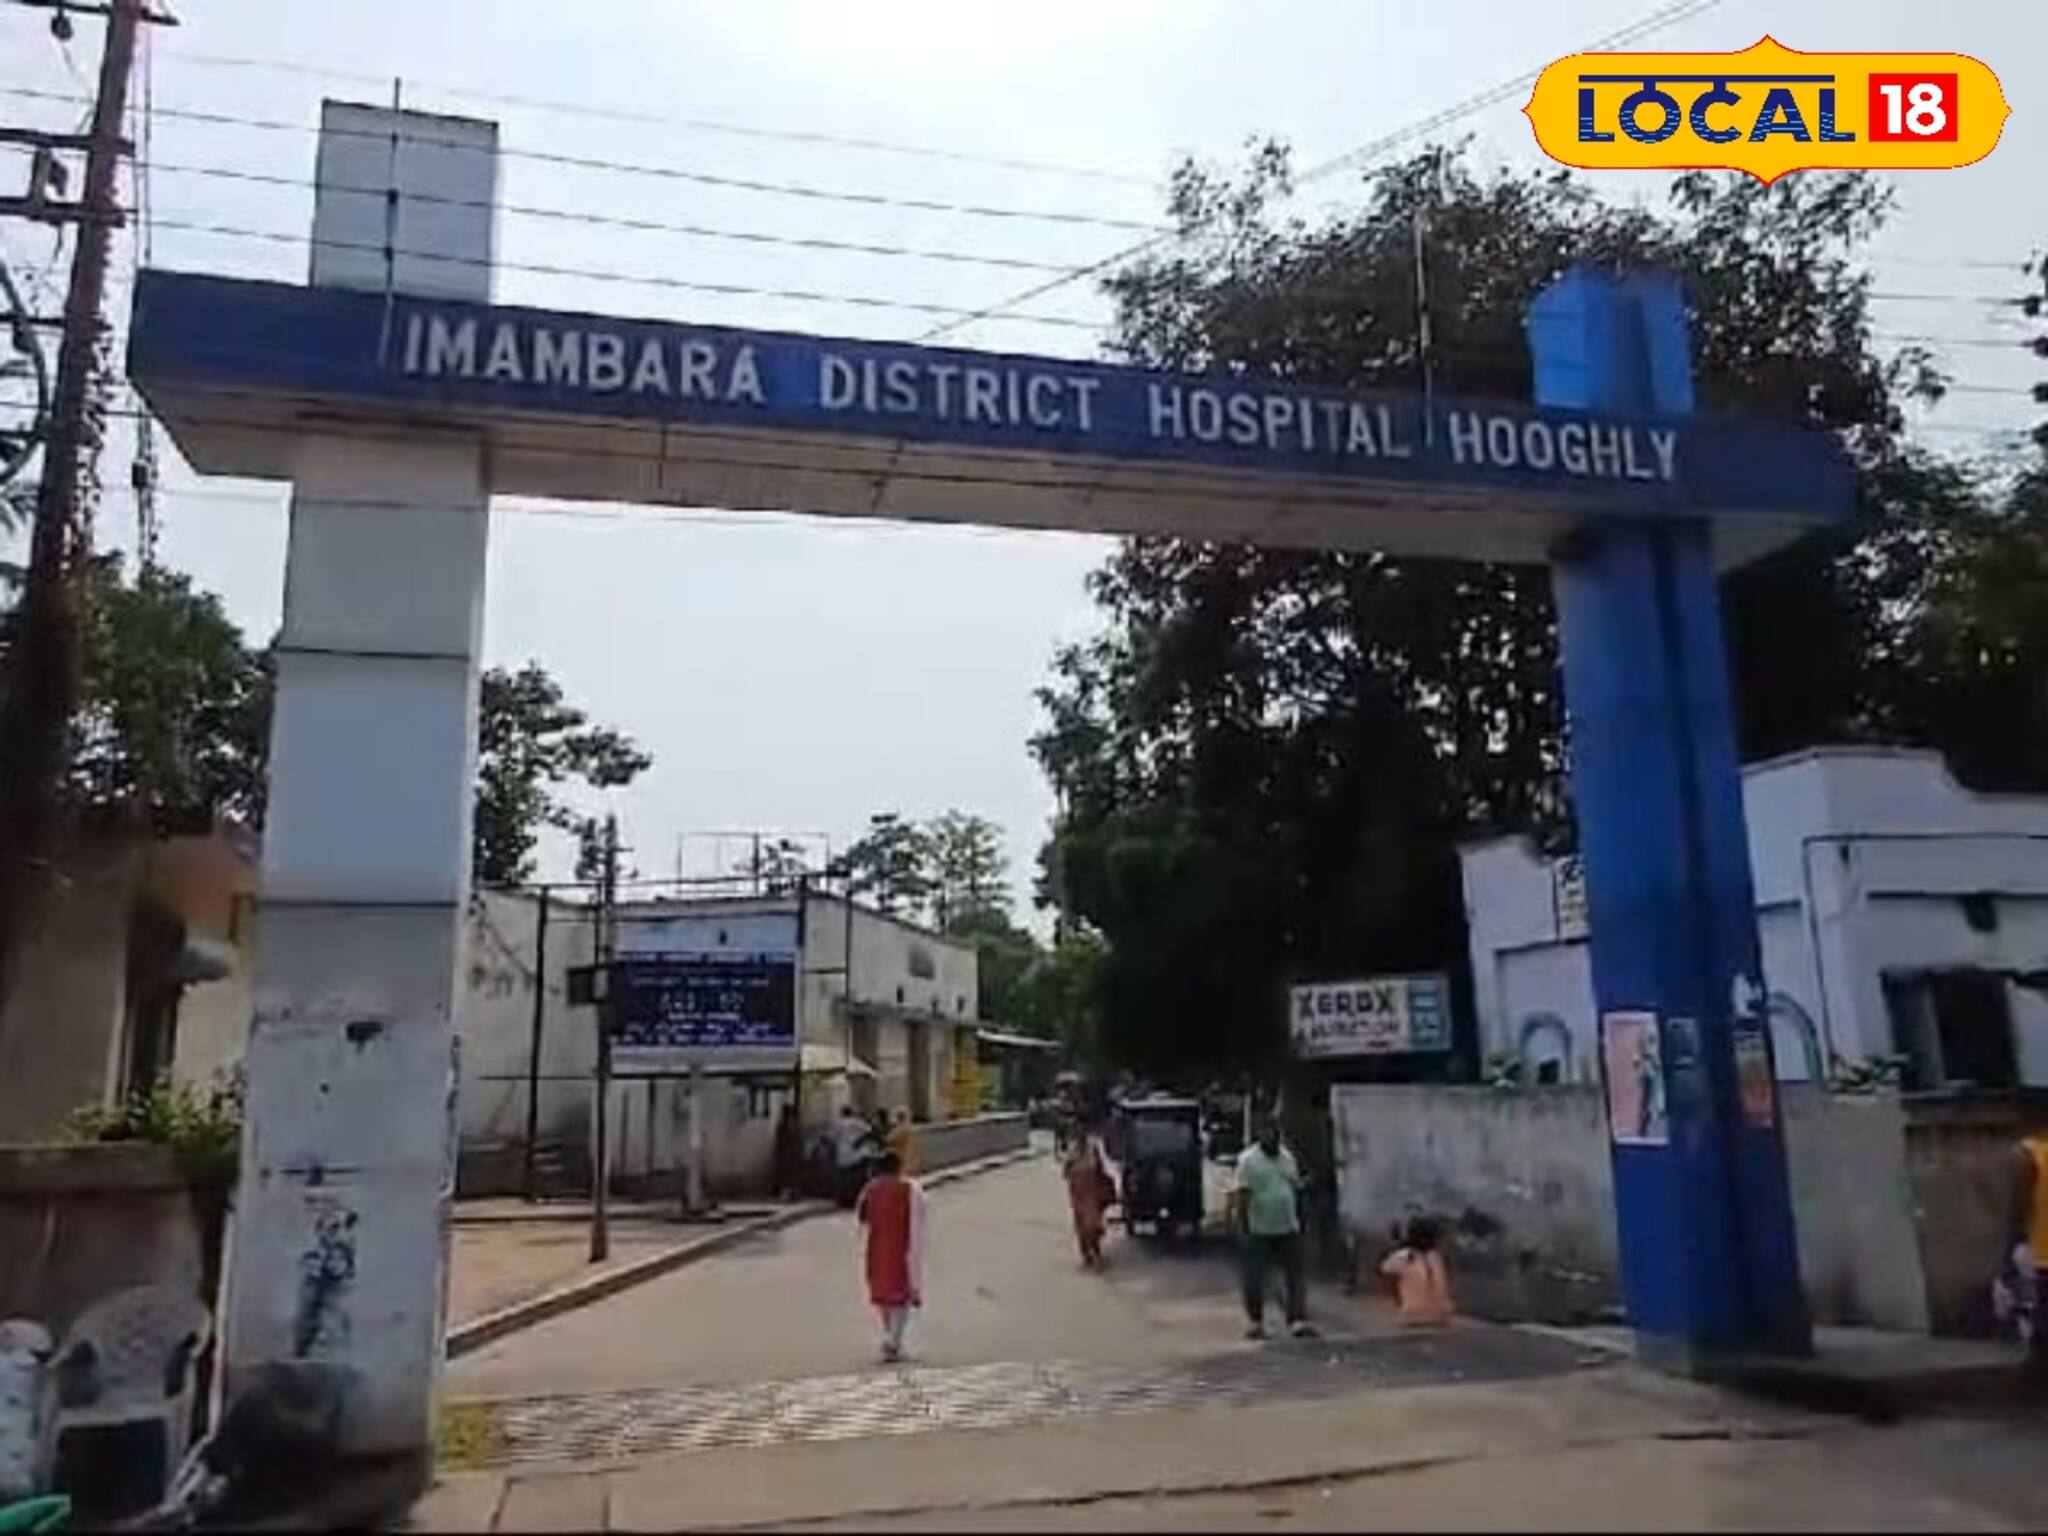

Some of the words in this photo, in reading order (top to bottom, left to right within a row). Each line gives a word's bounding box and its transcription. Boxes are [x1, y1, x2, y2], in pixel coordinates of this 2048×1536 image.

[404, 313, 766, 403] IMAMBARA
[819, 353, 1100, 432] DISTRICT
[1149, 382, 1412, 458] HOSPITAL
[1449, 410, 1677, 481] HOOGHLY
[1298, 986, 1395, 1017] XEROX
